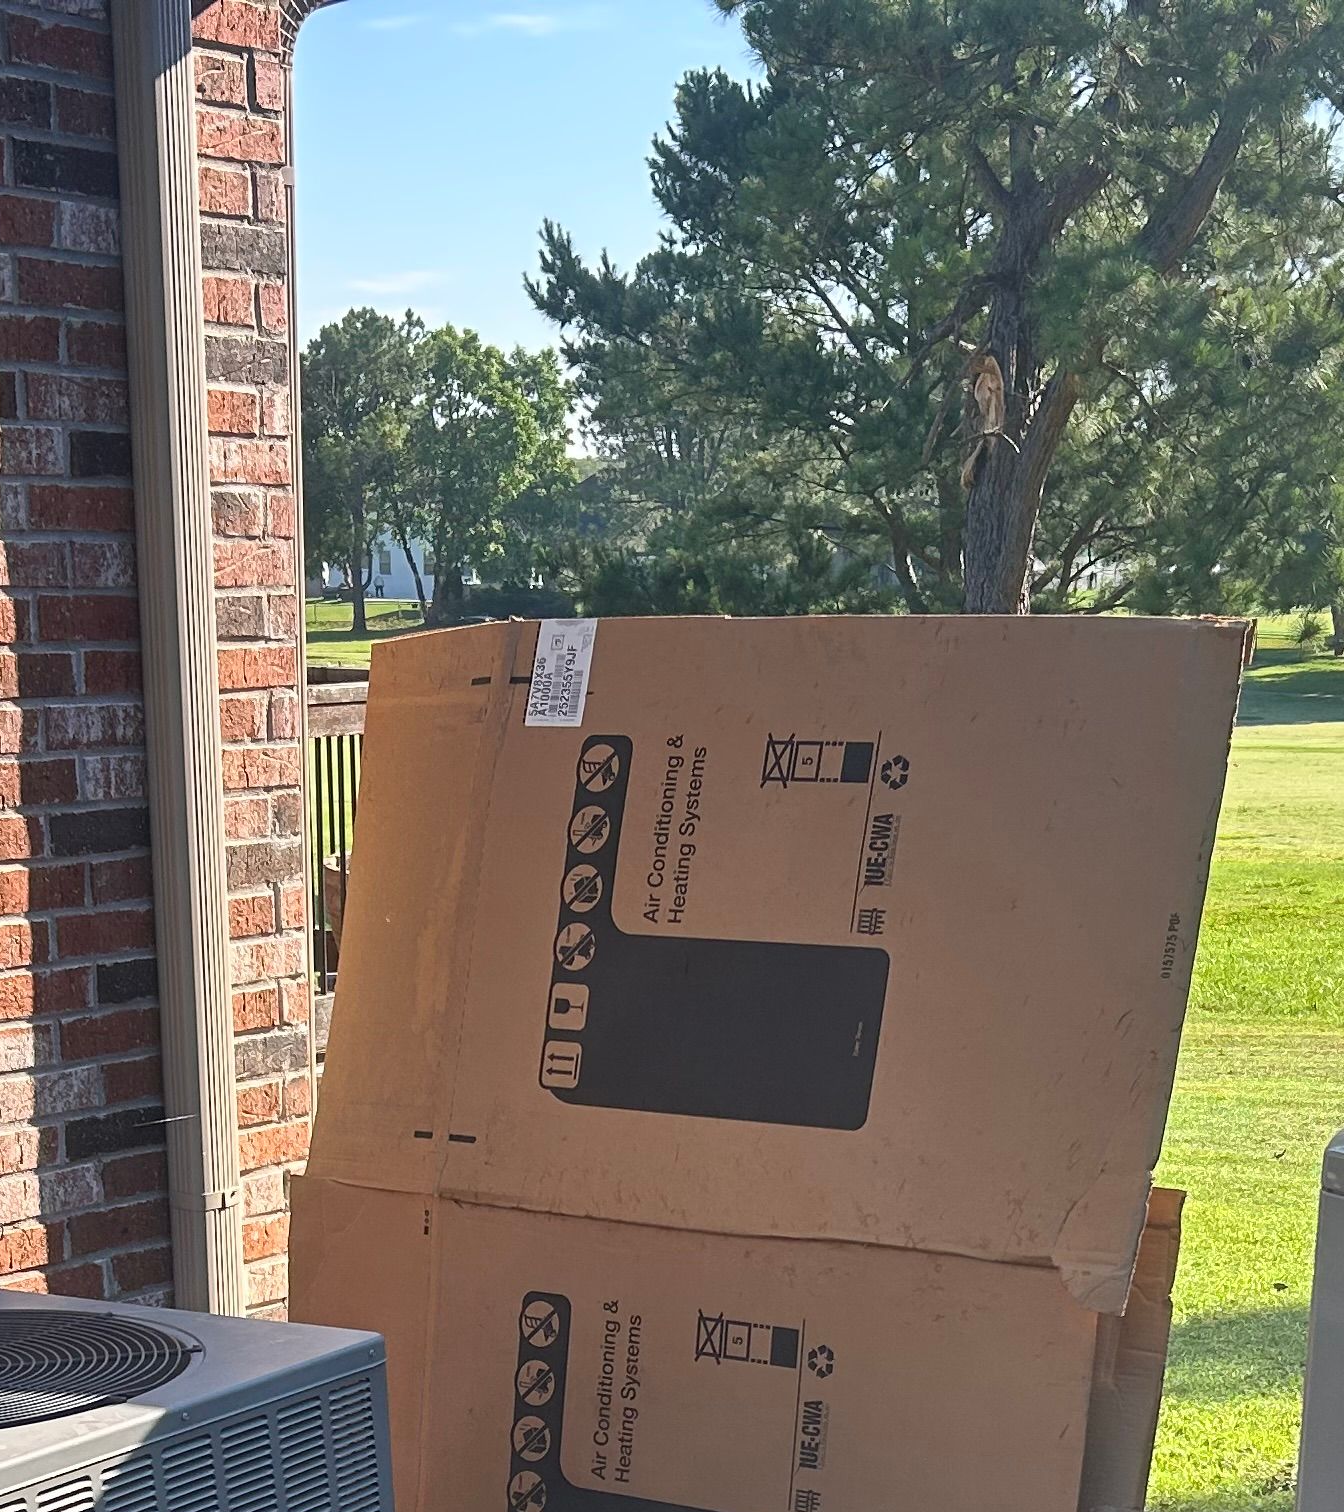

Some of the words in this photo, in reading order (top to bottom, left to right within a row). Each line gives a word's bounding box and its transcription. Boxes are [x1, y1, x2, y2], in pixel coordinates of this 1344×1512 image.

[558, 645, 577, 717] 252355Y9JF
[666, 735, 684, 749] &
[801, 757, 814, 766] 5
[647, 755, 685, 888] Conditioning
[679, 747, 707, 837] Systems
[643, 893, 661, 924] Air
[667, 843, 696, 924] Heating
[603, 1299, 619, 1314] &
[732, 1336, 744, 1345] 5
[593, 1319, 621, 1447] Conditioning
[620, 1314, 643, 1401] Systems
[591, 1451, 607, 1480] Air
[614, 1406, 639, 1483] Heating
